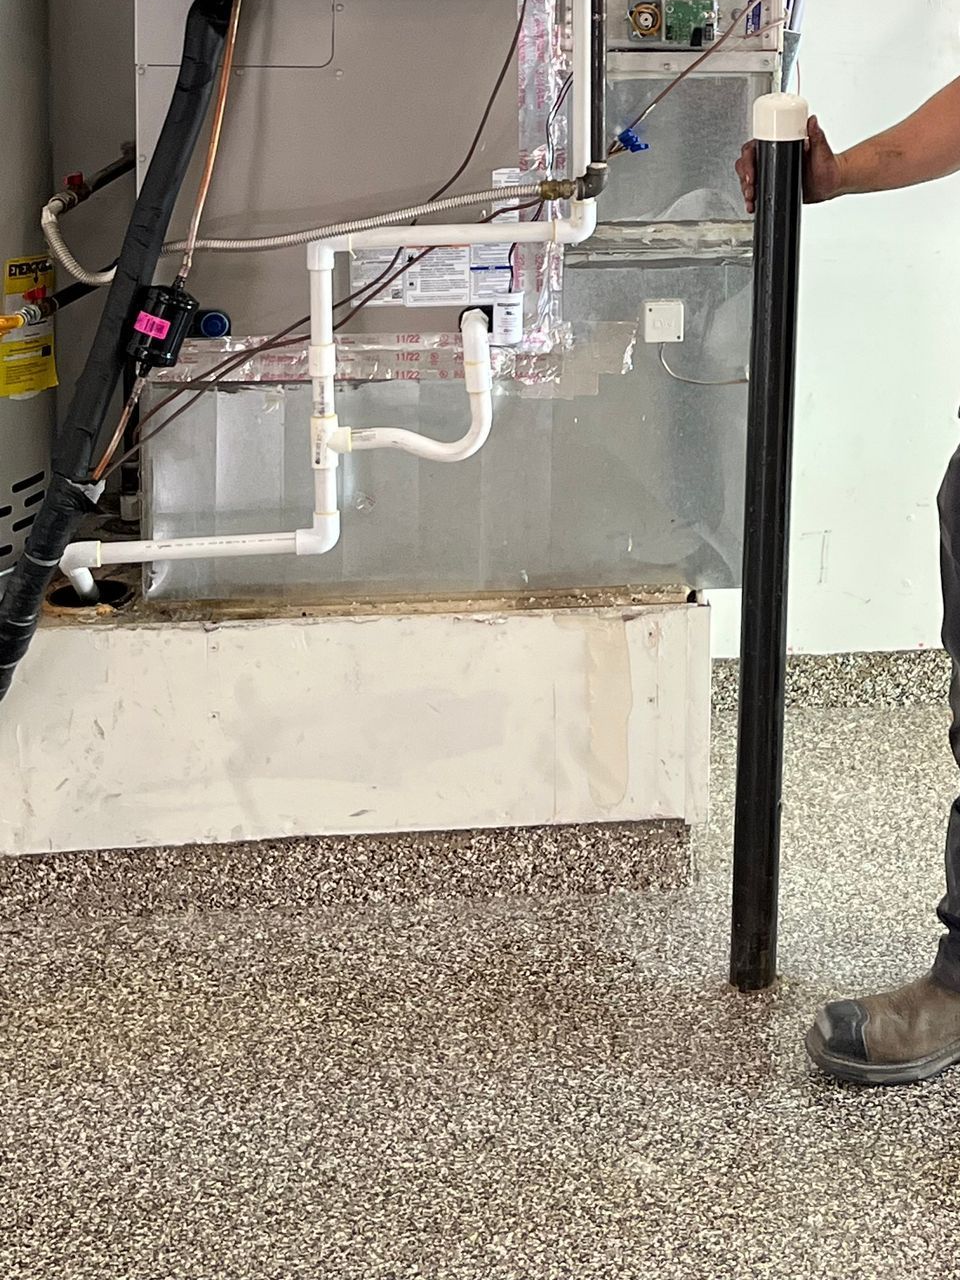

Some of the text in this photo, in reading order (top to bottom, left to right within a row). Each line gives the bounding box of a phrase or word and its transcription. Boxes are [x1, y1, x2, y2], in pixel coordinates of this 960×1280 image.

[396, 334, 420, 345] 11/22
[396, 352, 420, 362] 11/22
[396, 370, 420, 380] 11/22
